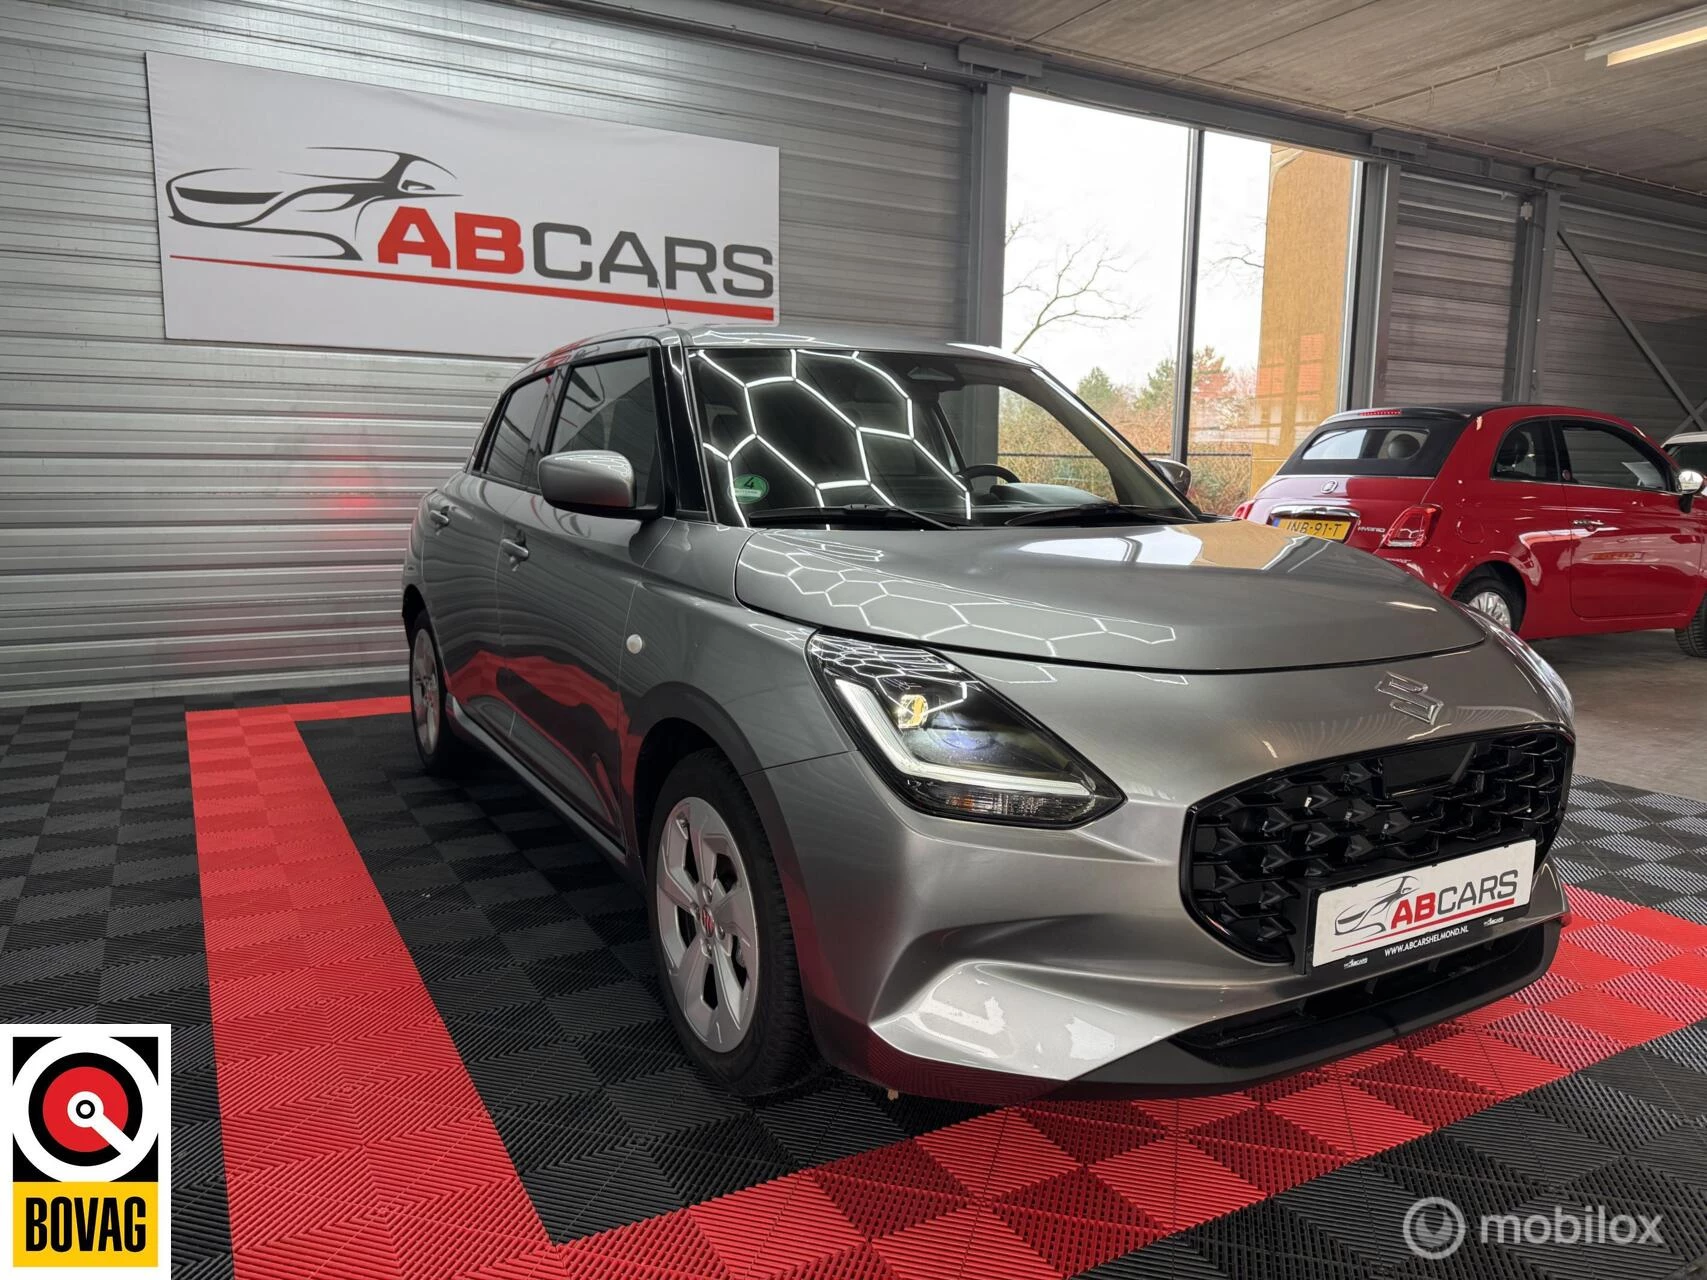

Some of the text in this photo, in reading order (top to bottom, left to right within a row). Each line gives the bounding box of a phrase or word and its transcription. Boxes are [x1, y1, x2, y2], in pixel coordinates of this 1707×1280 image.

[377, 206, 774, 298] ABCARS
[743, 477, 755, 489] 4
[1390, 869, 1519, 930] ABCARS
[1384, 925, 1469, 957] WWW.ABCARSHELMOND.NL
